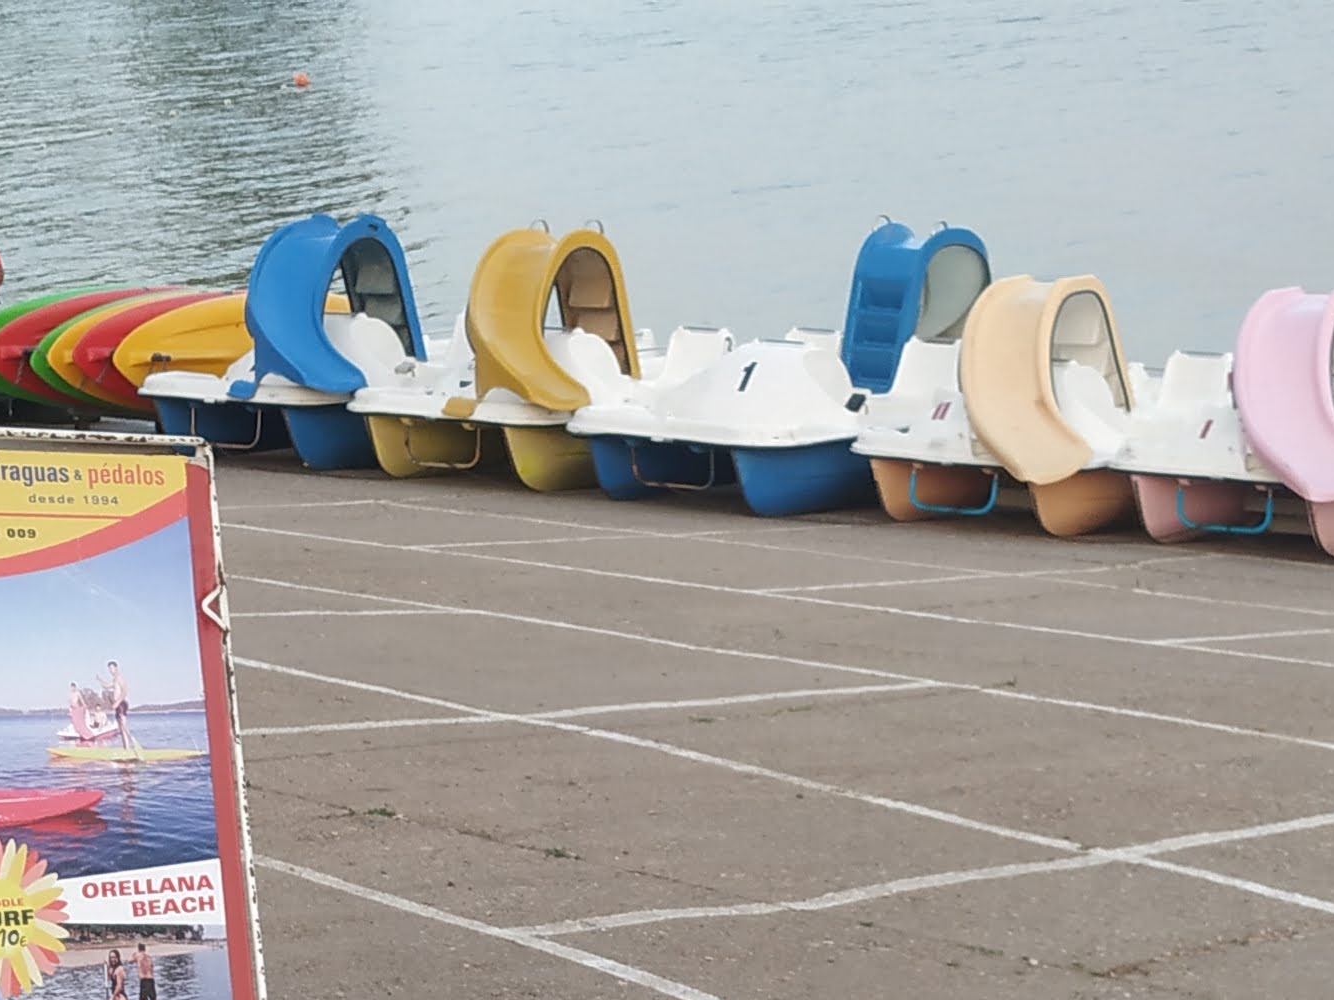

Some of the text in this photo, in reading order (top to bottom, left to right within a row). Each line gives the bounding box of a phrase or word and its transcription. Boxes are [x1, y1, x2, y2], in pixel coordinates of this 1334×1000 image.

[737, 361, 758, 392] 1
[74, 469, 82, 481] &
[88, 462, 165, 489] pédalos
[28, 494, 119, 505] desde 1994
[7, 528, 37, 539] 009
[82, 874, 215, 899] ORELLANA
[131, 895, 215, 917] BEACH
